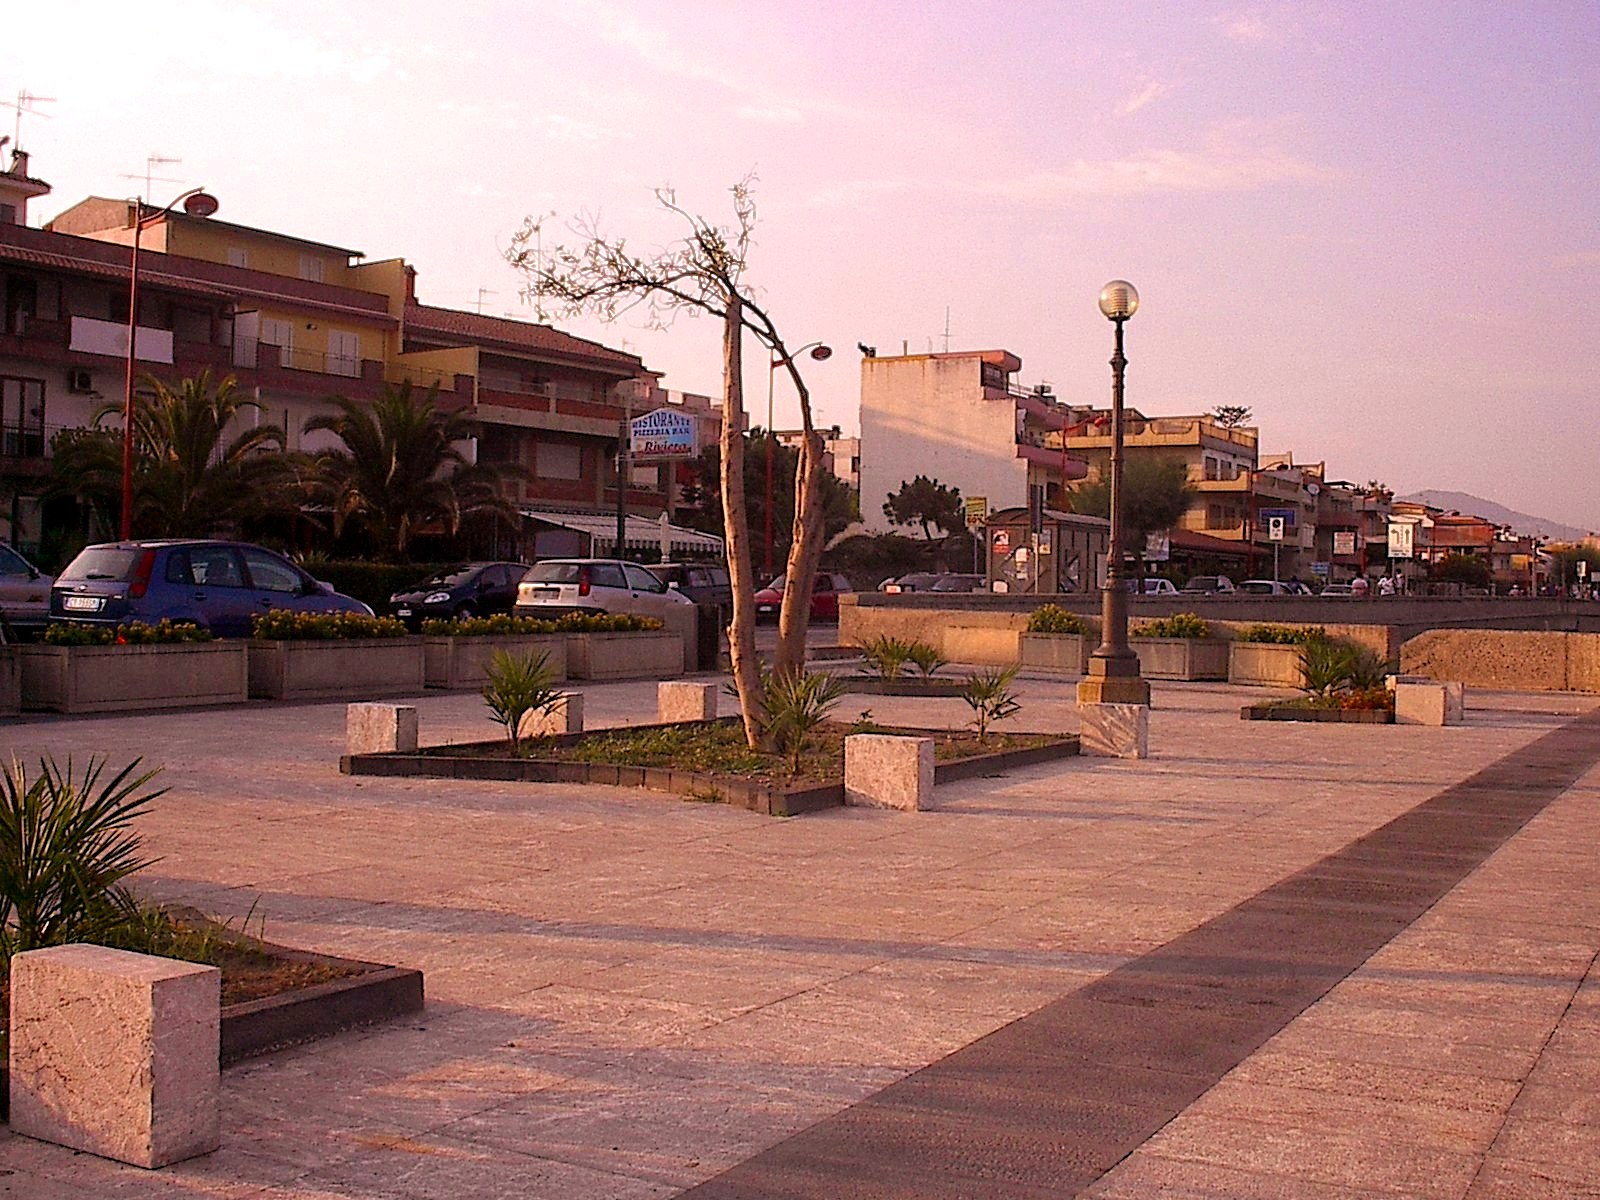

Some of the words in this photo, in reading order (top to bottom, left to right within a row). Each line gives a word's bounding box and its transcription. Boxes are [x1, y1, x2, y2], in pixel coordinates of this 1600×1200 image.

[632, 412, 690, 428] RISTORANTE
[633, 428, 670, 436] PIZZERIA
[645, 441, 687, 452] Riviera
